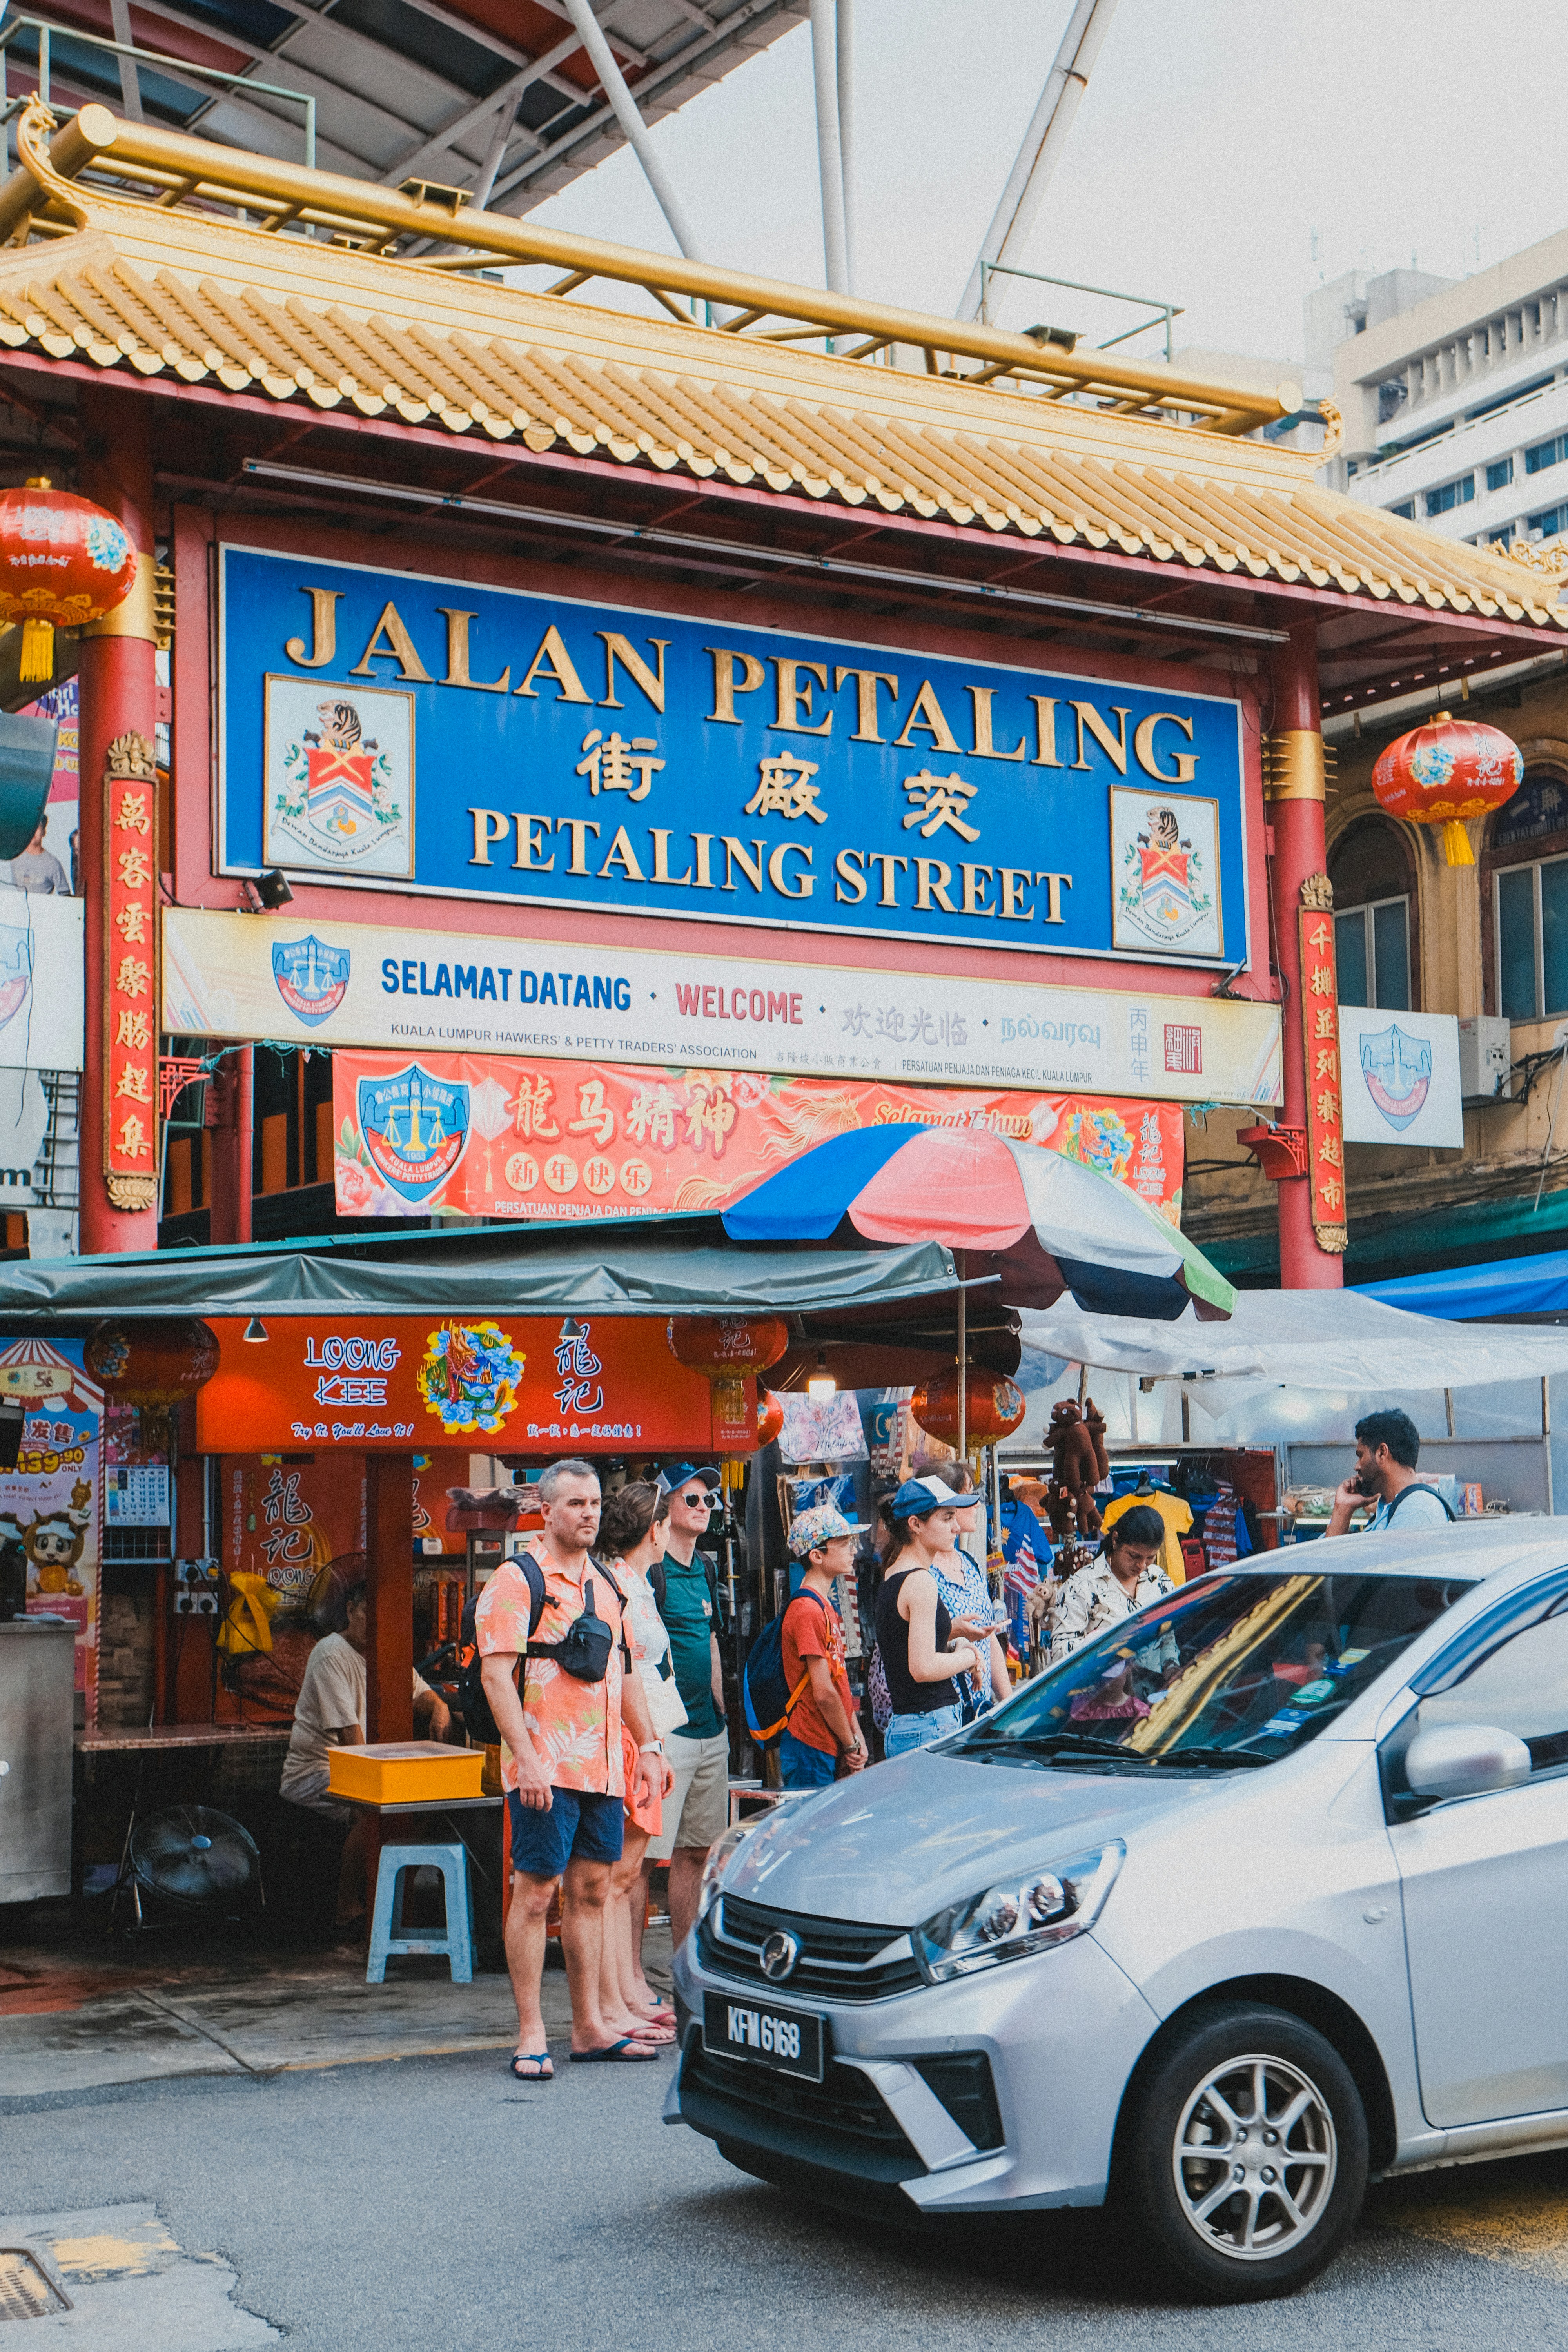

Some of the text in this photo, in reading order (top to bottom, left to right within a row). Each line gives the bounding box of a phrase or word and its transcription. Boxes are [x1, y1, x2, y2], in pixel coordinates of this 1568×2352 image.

[285, 586, 1201, 783] JALAN PETALING
[468, 808, 1073, 923] PETALING STREET
[381, 958, 513, 1002] SELAMAT
[520, 970, 631, 1011] DATANG
[675, 982, 804, 1024] WELCOME
[391, 1024, 757, 1059] KUALA LUMPUR HAWKERS' & PETTY TRADERS' ASSOCIATION
[842, 1003, 968, 1047] 欢迎光临
[1001, 1013, 1100, 1049] நல்வரவு
[1129, 1008, 1149, 1082] 丙申年
[902, 1059, 1093, 1083] PERSATUAN PENJAJA DAN PENIAGA KECIL KUALA LUMPUR
[872, 1101, 966, 1127] Selamat
[389, 1154, 443, 1173] KUALA LUMPUR
[402, 1172, 424, 1181] PETTY
[510, 1158, 646, 1191] 新年快乐
[495, 1201, 556, 1215] PERSATUAN
[559, 1203, 603, 1216] PENJAJA
[604, 1205, 627, 1217] DAN
[303, 1337, 402, 1372] LOONG
[553, 1322, 604, 1414] 龍記
[314, 1375, 388, 1406] KEE
[291, 1422, 312, 1441] Try
[332, 1422, 365, 1441] You'll
[365, 1423, 392, 1438] Love
[260, 1469, 313, 1564] 龍記
[760, 2014, 801, 2059] 6168
